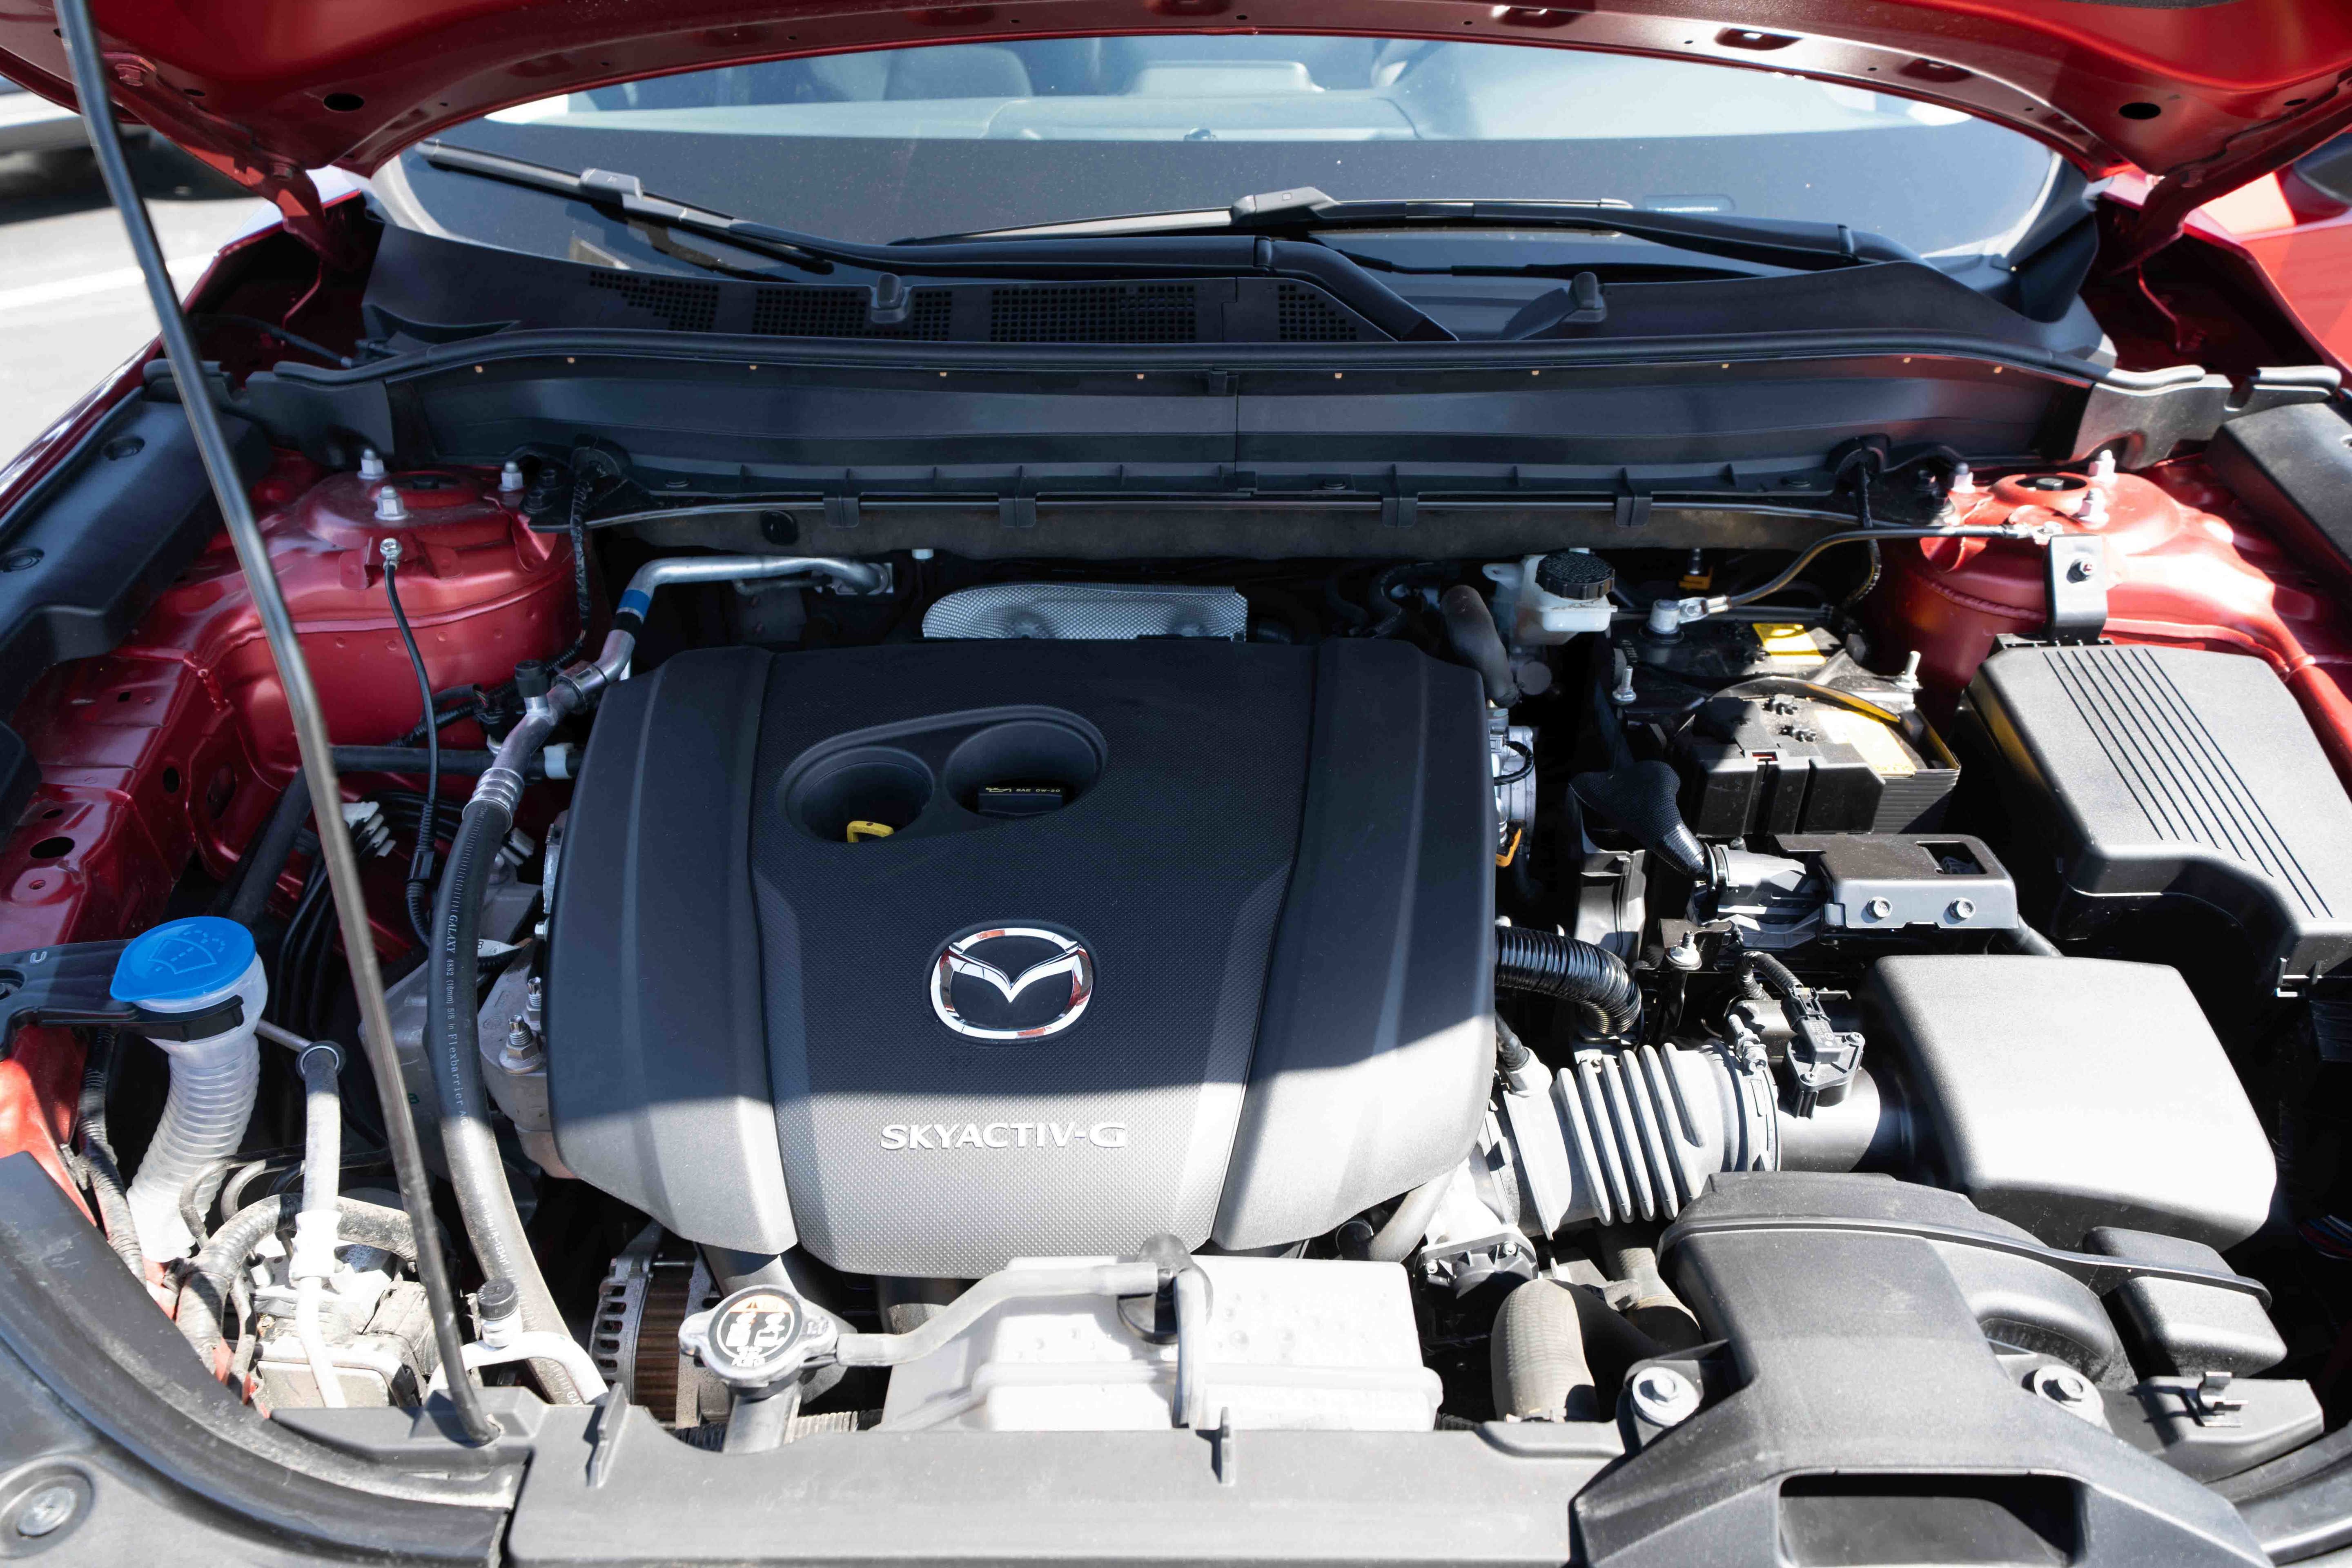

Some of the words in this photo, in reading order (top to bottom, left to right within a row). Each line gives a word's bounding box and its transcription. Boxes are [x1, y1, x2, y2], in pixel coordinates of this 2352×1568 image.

[446, 915, 458, 953] GALAXY
[446, 959, 454, 976] 4882
[445, 980, 454, 1004] (16mm)
[448, 1033, 464, 1106] Flexbarrier
[459, 1111, 469, 1126] A/C
[880, 1123, 1126, 1150] SKYACTIV-G
